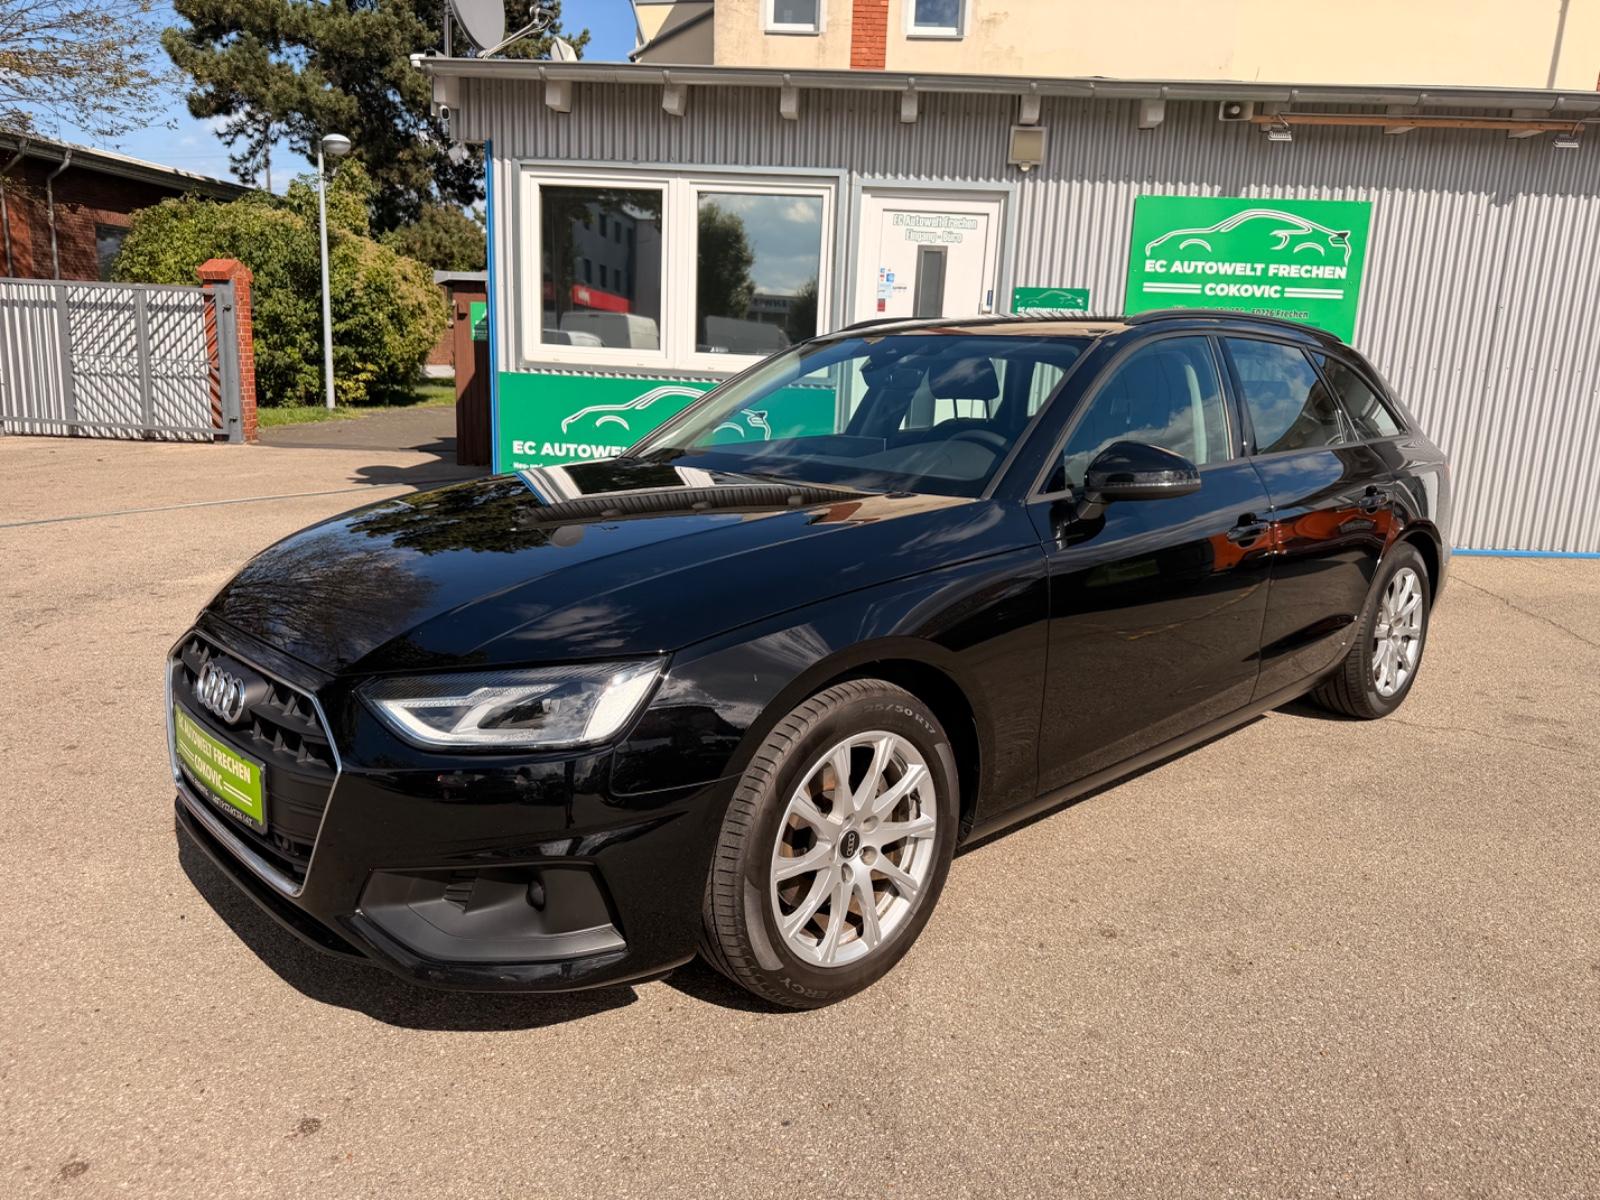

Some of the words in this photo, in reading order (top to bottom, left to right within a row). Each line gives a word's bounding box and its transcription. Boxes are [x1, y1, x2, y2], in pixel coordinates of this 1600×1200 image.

[1144, 259, 1166, 273] EC
[1169, 262, 1265, 277] AUTOWELT
[1268, 263, 1347, 280] FRECHEN
[1204, 282, 1282, 299] COKOVIC
[512, 439, 537, 456] EC
[213, 746, 252, 785] FRECHEN
